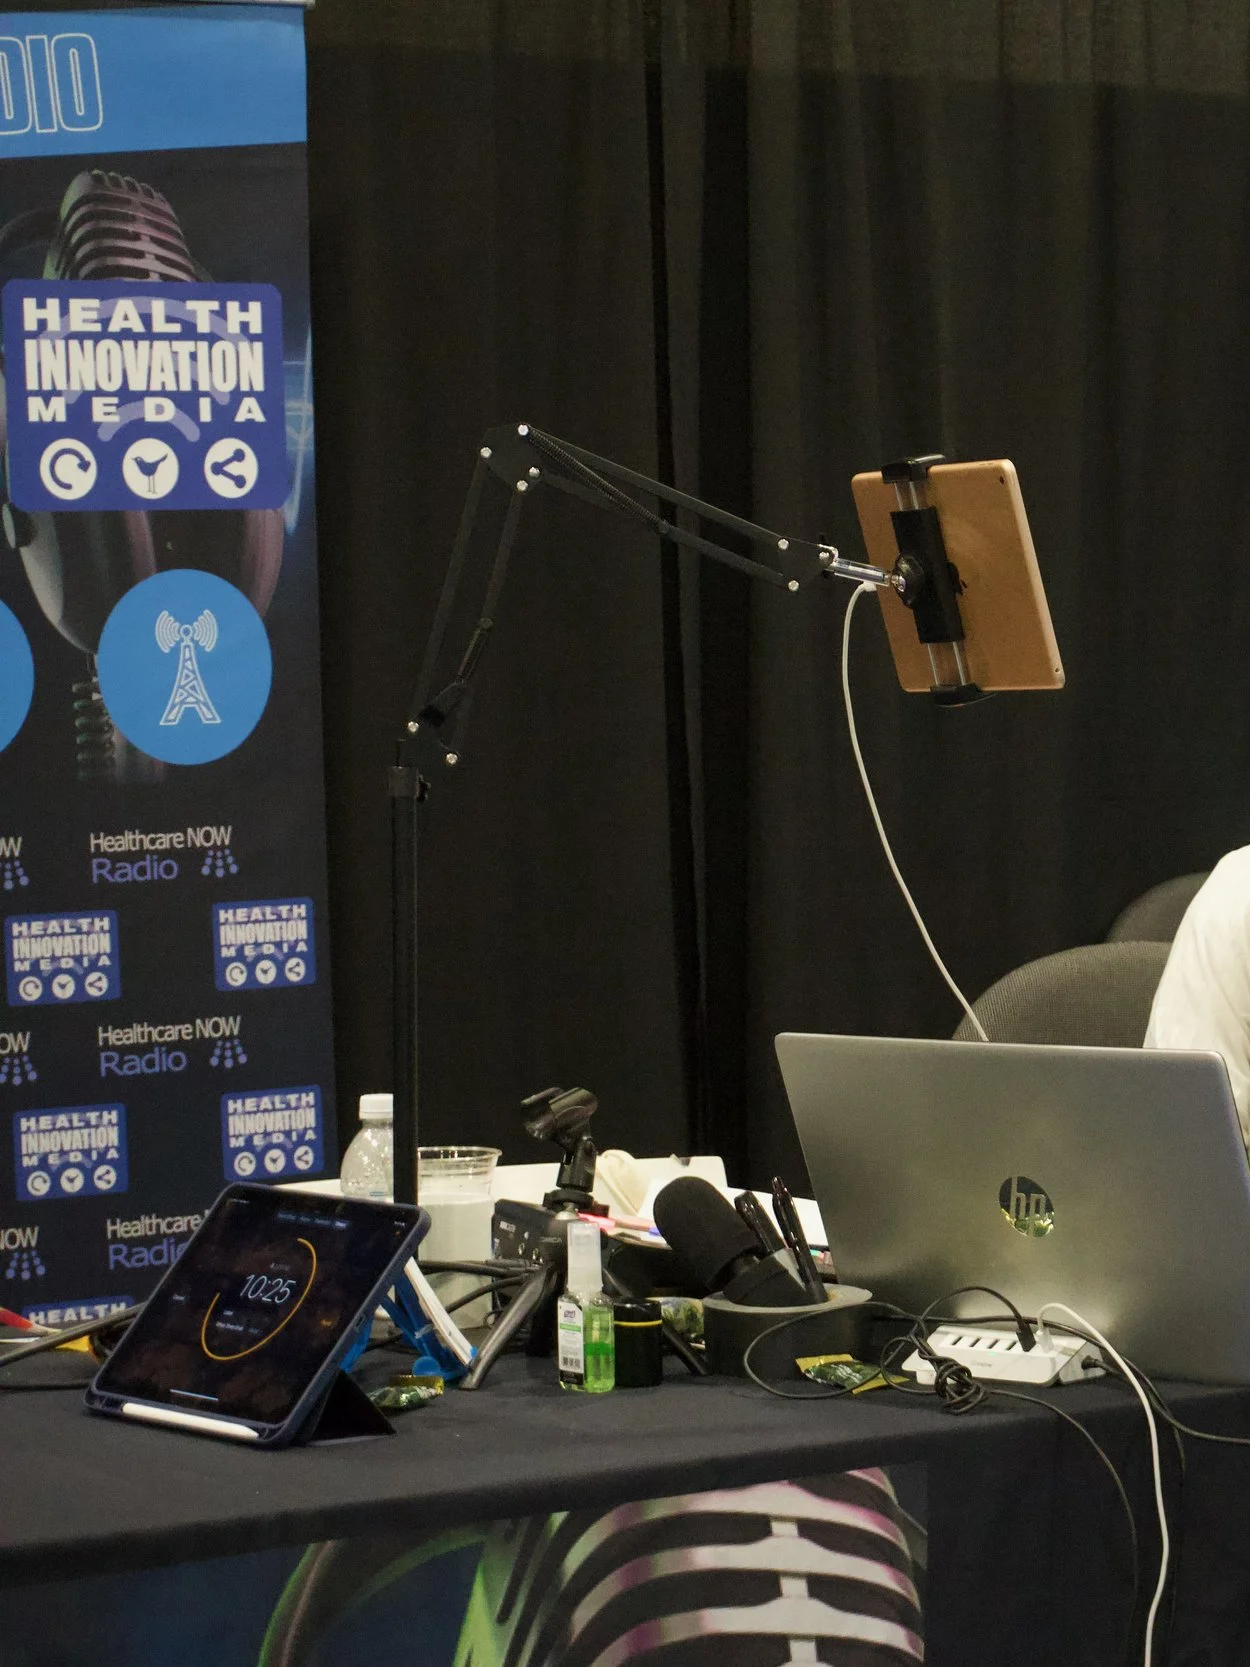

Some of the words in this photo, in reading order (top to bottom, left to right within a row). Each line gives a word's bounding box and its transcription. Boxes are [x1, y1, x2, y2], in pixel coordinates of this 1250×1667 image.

[23, 298, 263, 334] HEALTH
[25, 339, 265, 392] INNOVATION
[28, 396, 266, 423] MEDIA
[90, 830, 184, 852] Healthcare
[187, 826, 232, 848] NOW
[91, 855, 178, 884] Radio
[12, 917, 110, 937] HEALTH
[219, 904, 306, 923] HEALTH
[13, 932, 111, 959] INNOVATION
[220, 919, 308, 945] INNOVATION
[221, 941, 308, 958] MEDIA
[14, 955, 111, 973] MEDIA
[98, 1022, 193, 1047] Healthcare
[196, 1015, 241, 1038] NOW
[100, 1045, 187, 1077] Radio
[227, 1092, 315, 1113] HEALTH
[20, 1110, 118, 1131] HEALTH
[228, 1107, 316, 1136] INNOVATION
[21, 1125, 119, 1155] INNOVATION
[229, 1129, 316, 1148] MEDIA
[22, 1149, 120, 1168] MEDIA
[1009, 1176, 1047, 1237] hp
[107, 1212, 203, 1239] Healthcare
[240, 1274, 296, 1304] 10:25
[29, 1302, 127, 1324] HEALTH
